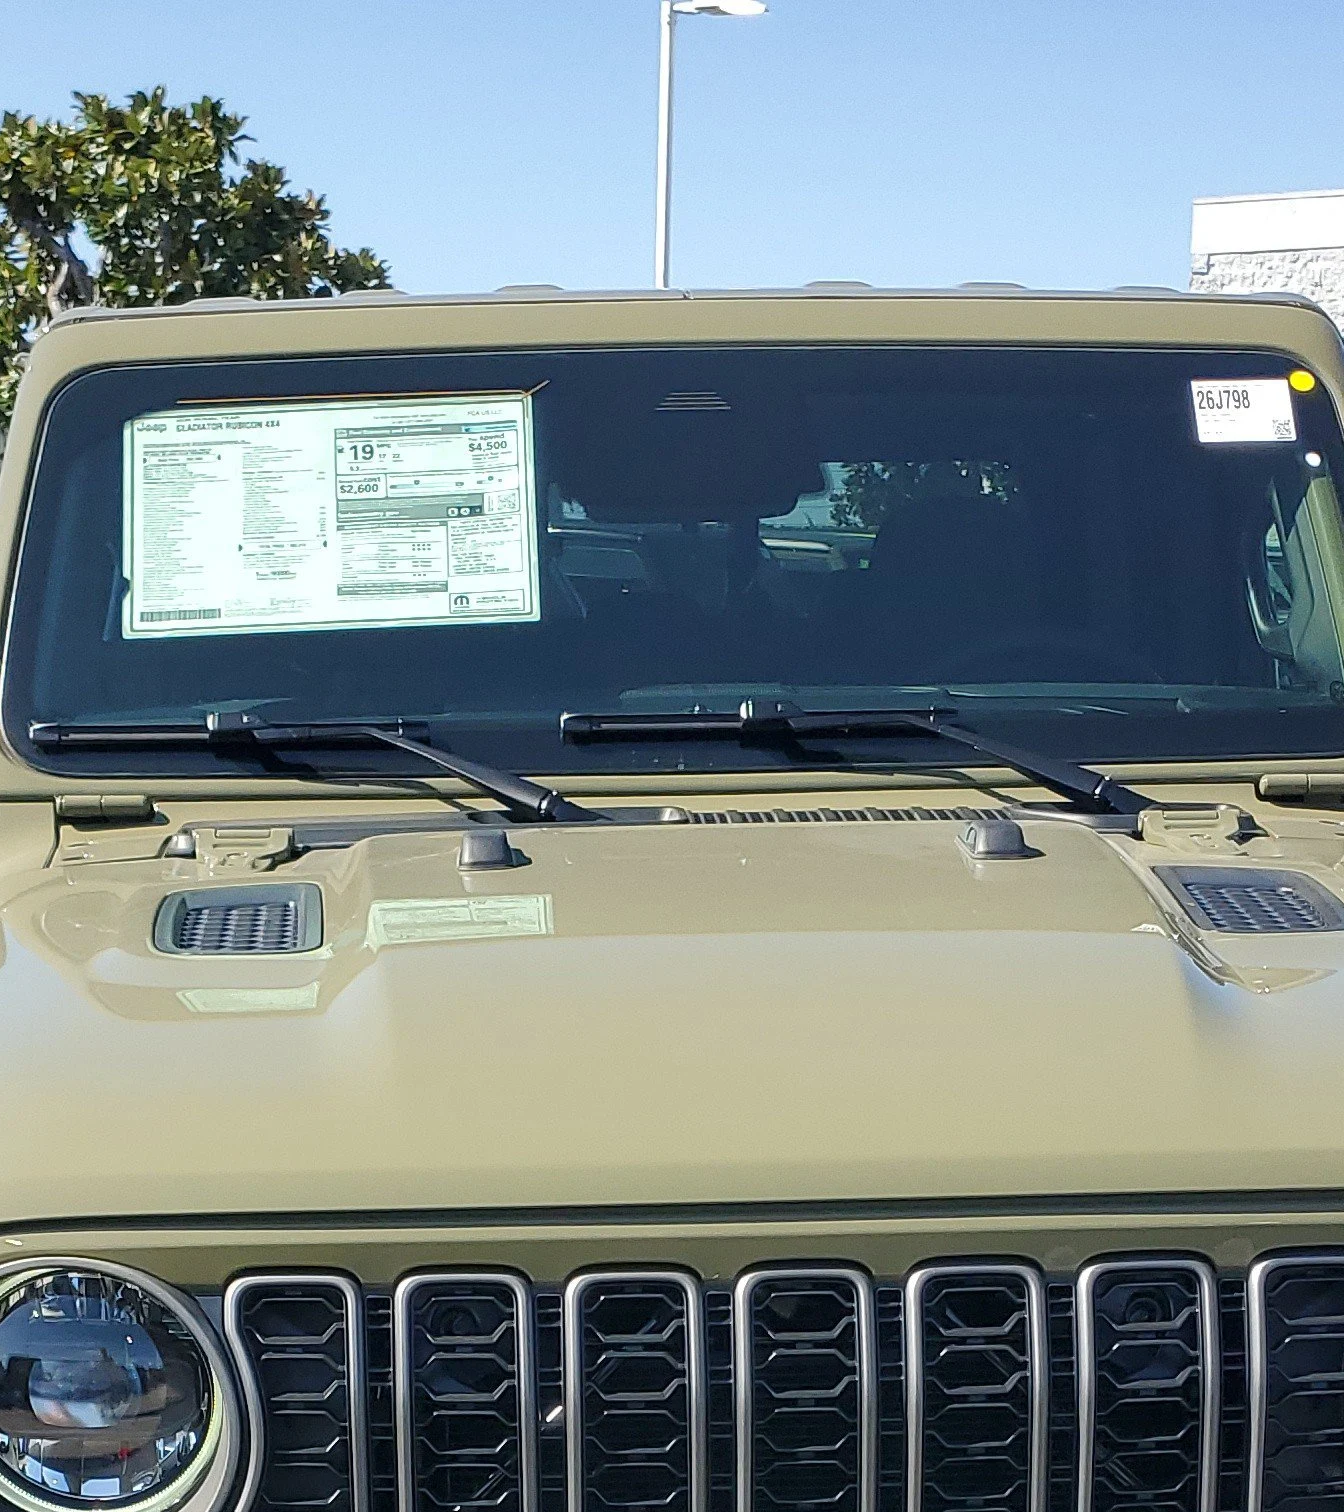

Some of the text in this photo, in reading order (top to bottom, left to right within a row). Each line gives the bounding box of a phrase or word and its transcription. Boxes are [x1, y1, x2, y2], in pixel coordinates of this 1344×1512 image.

[1196, 389, 1251, 410] 26J798
[136, 422, 168, 434] Jeep
[349, 443, 375, 461] 19
[468, 440, 508, 453] $4,500
[339, 483, 379, 495] $2,600
